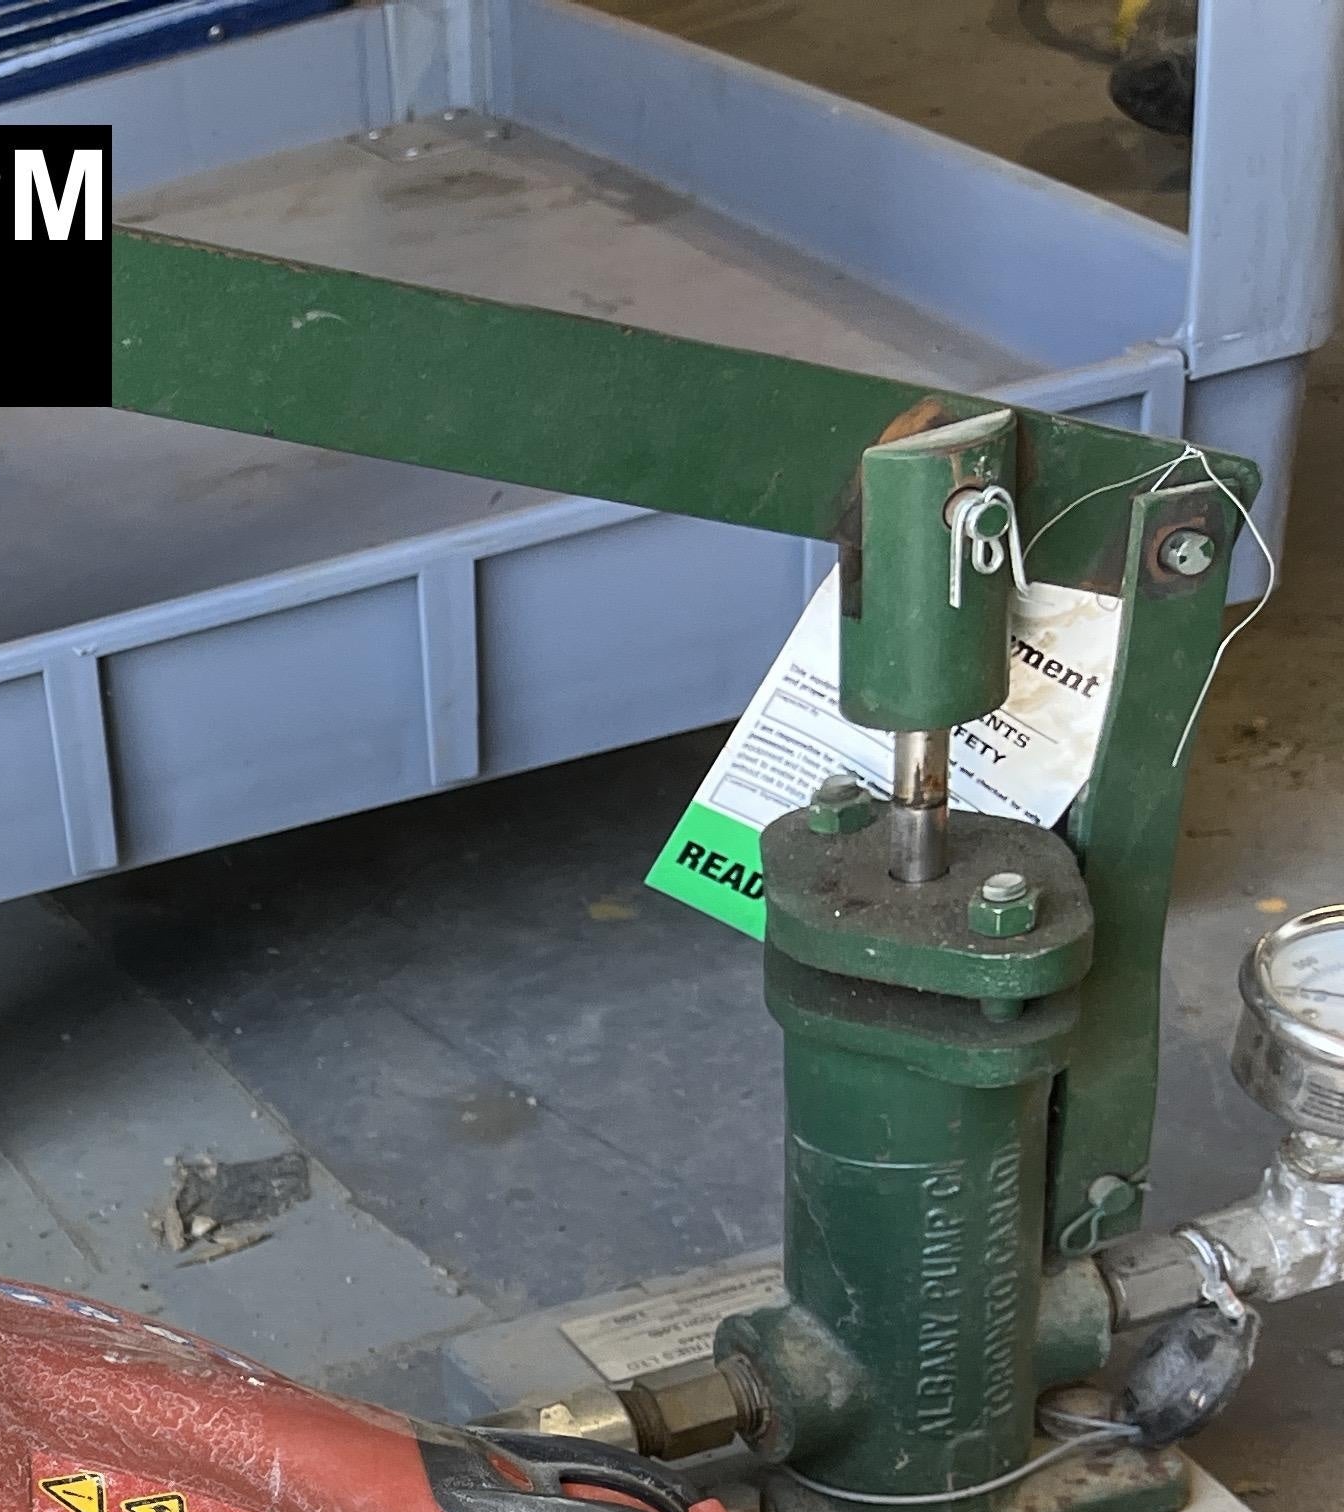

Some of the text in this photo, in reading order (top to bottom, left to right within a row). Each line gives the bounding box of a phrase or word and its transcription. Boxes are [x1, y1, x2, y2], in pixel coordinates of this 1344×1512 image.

[982, 713, 1032, 749] NTS
[919, 1207, 965, 1299] PUMP
[916, 1312, 961, 1436] ALBANY
